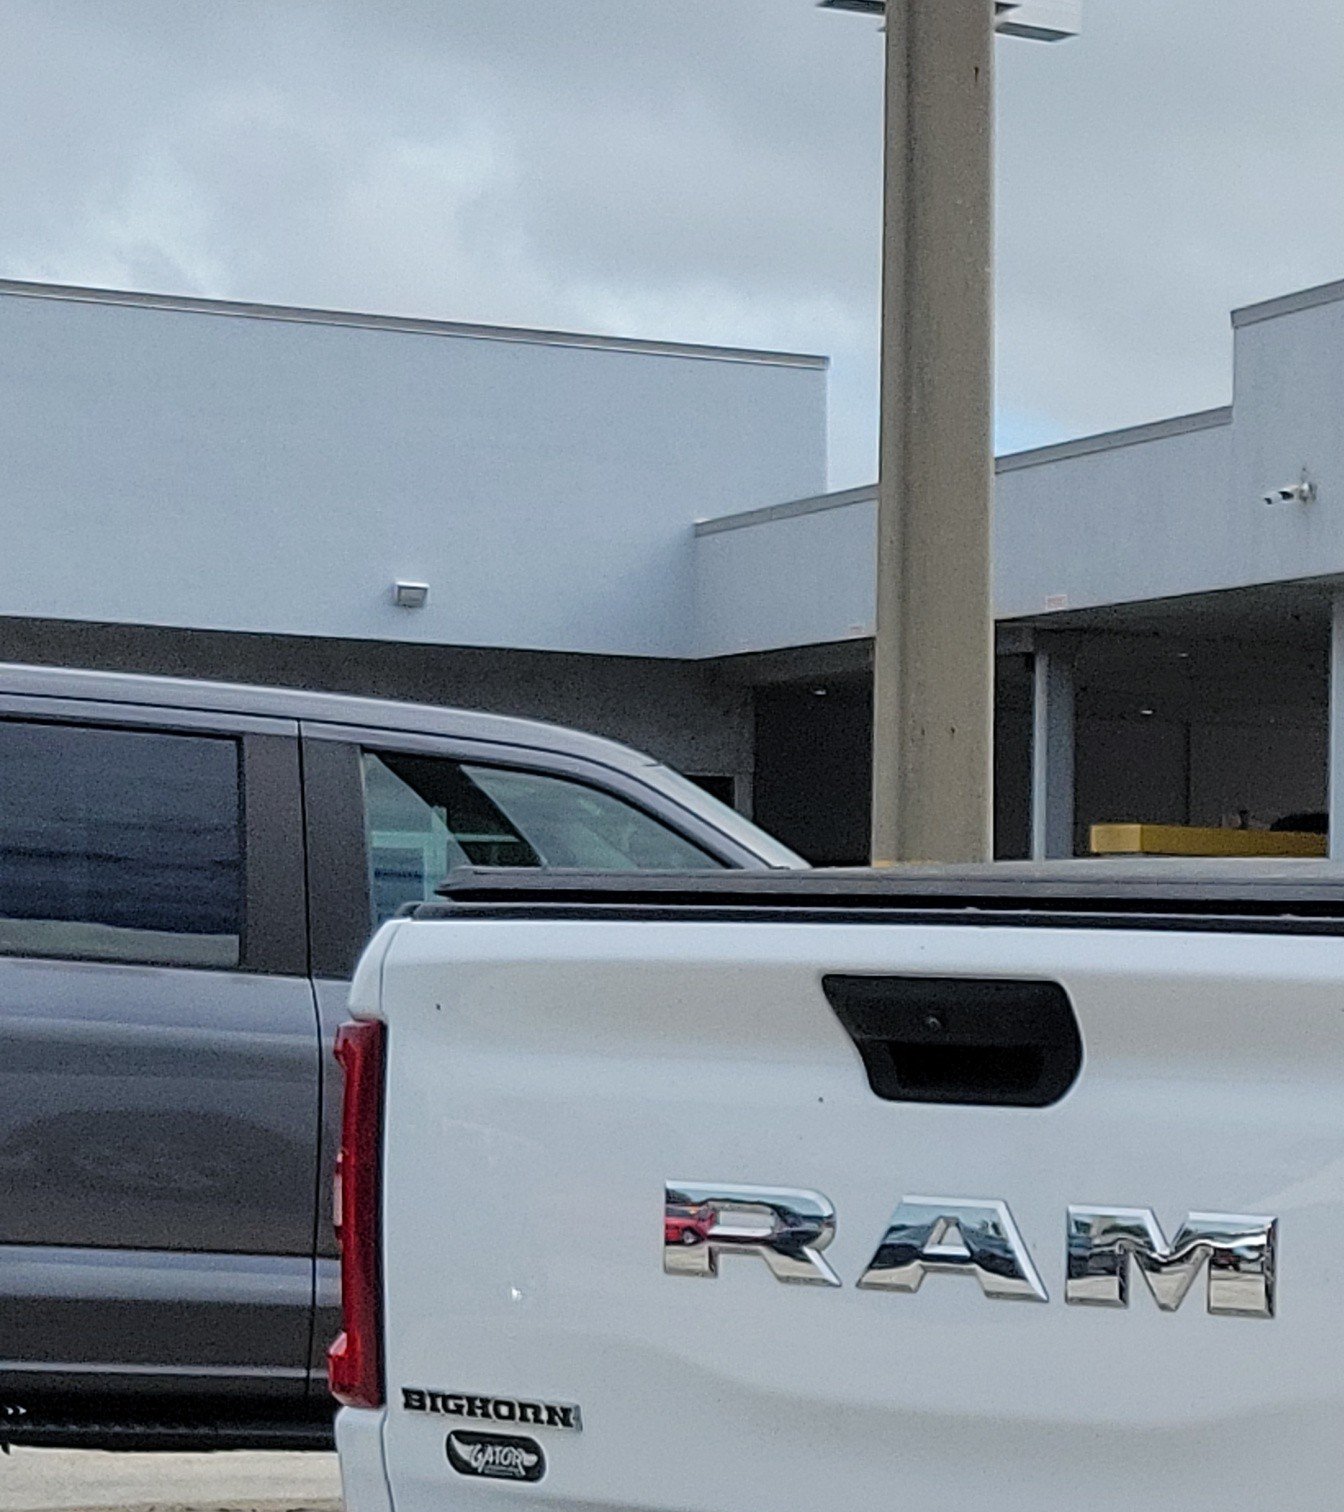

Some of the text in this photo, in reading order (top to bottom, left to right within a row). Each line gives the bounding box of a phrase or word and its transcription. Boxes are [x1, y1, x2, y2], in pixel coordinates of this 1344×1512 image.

[664, 1178, 1279, 1320] RAM
[401, 1386, 582, 1432] BIGHORN
[470, 1443, 526, 1476] GATOR
